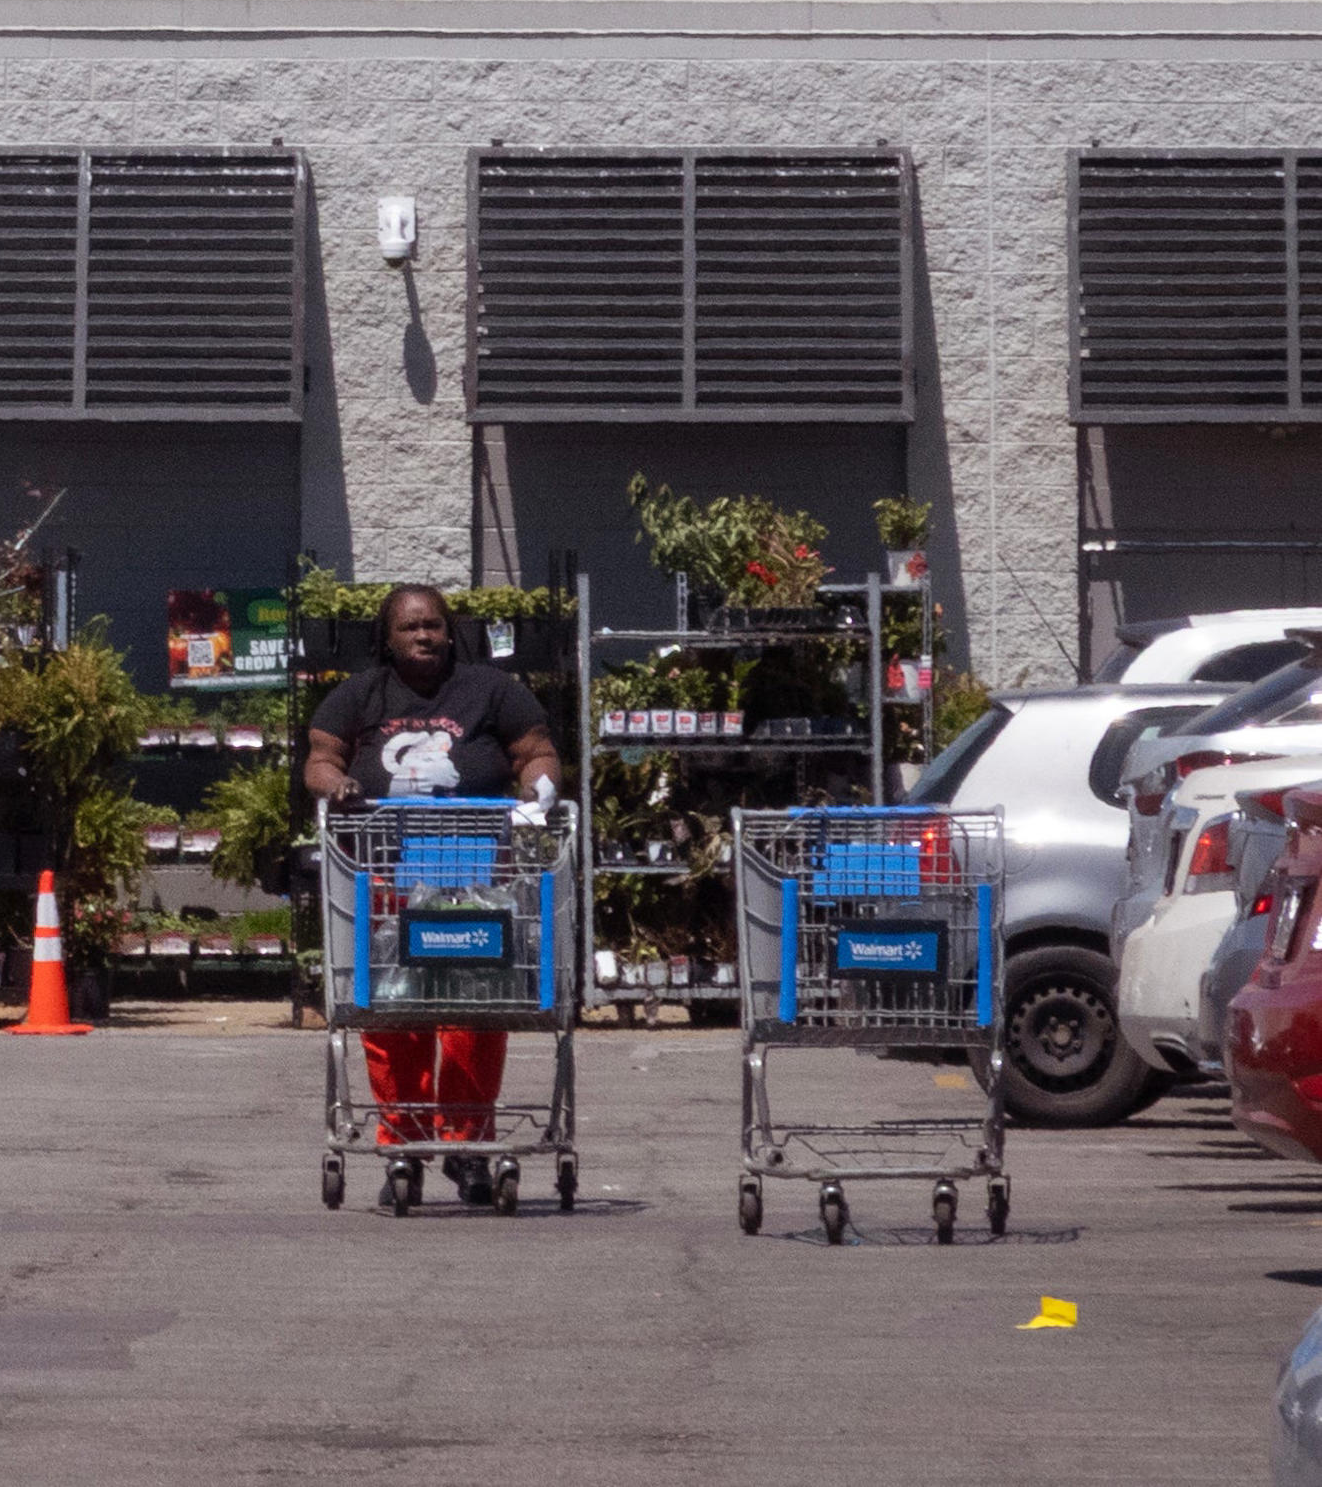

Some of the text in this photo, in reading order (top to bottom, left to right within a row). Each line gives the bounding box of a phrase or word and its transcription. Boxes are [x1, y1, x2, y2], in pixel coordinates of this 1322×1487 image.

[250, 639, 284, 656] SAVE
[234, 656, 277, 670] GROW
[421, 931, 472, 944] Walmart
[851, 942, 904, 956] Walmart
